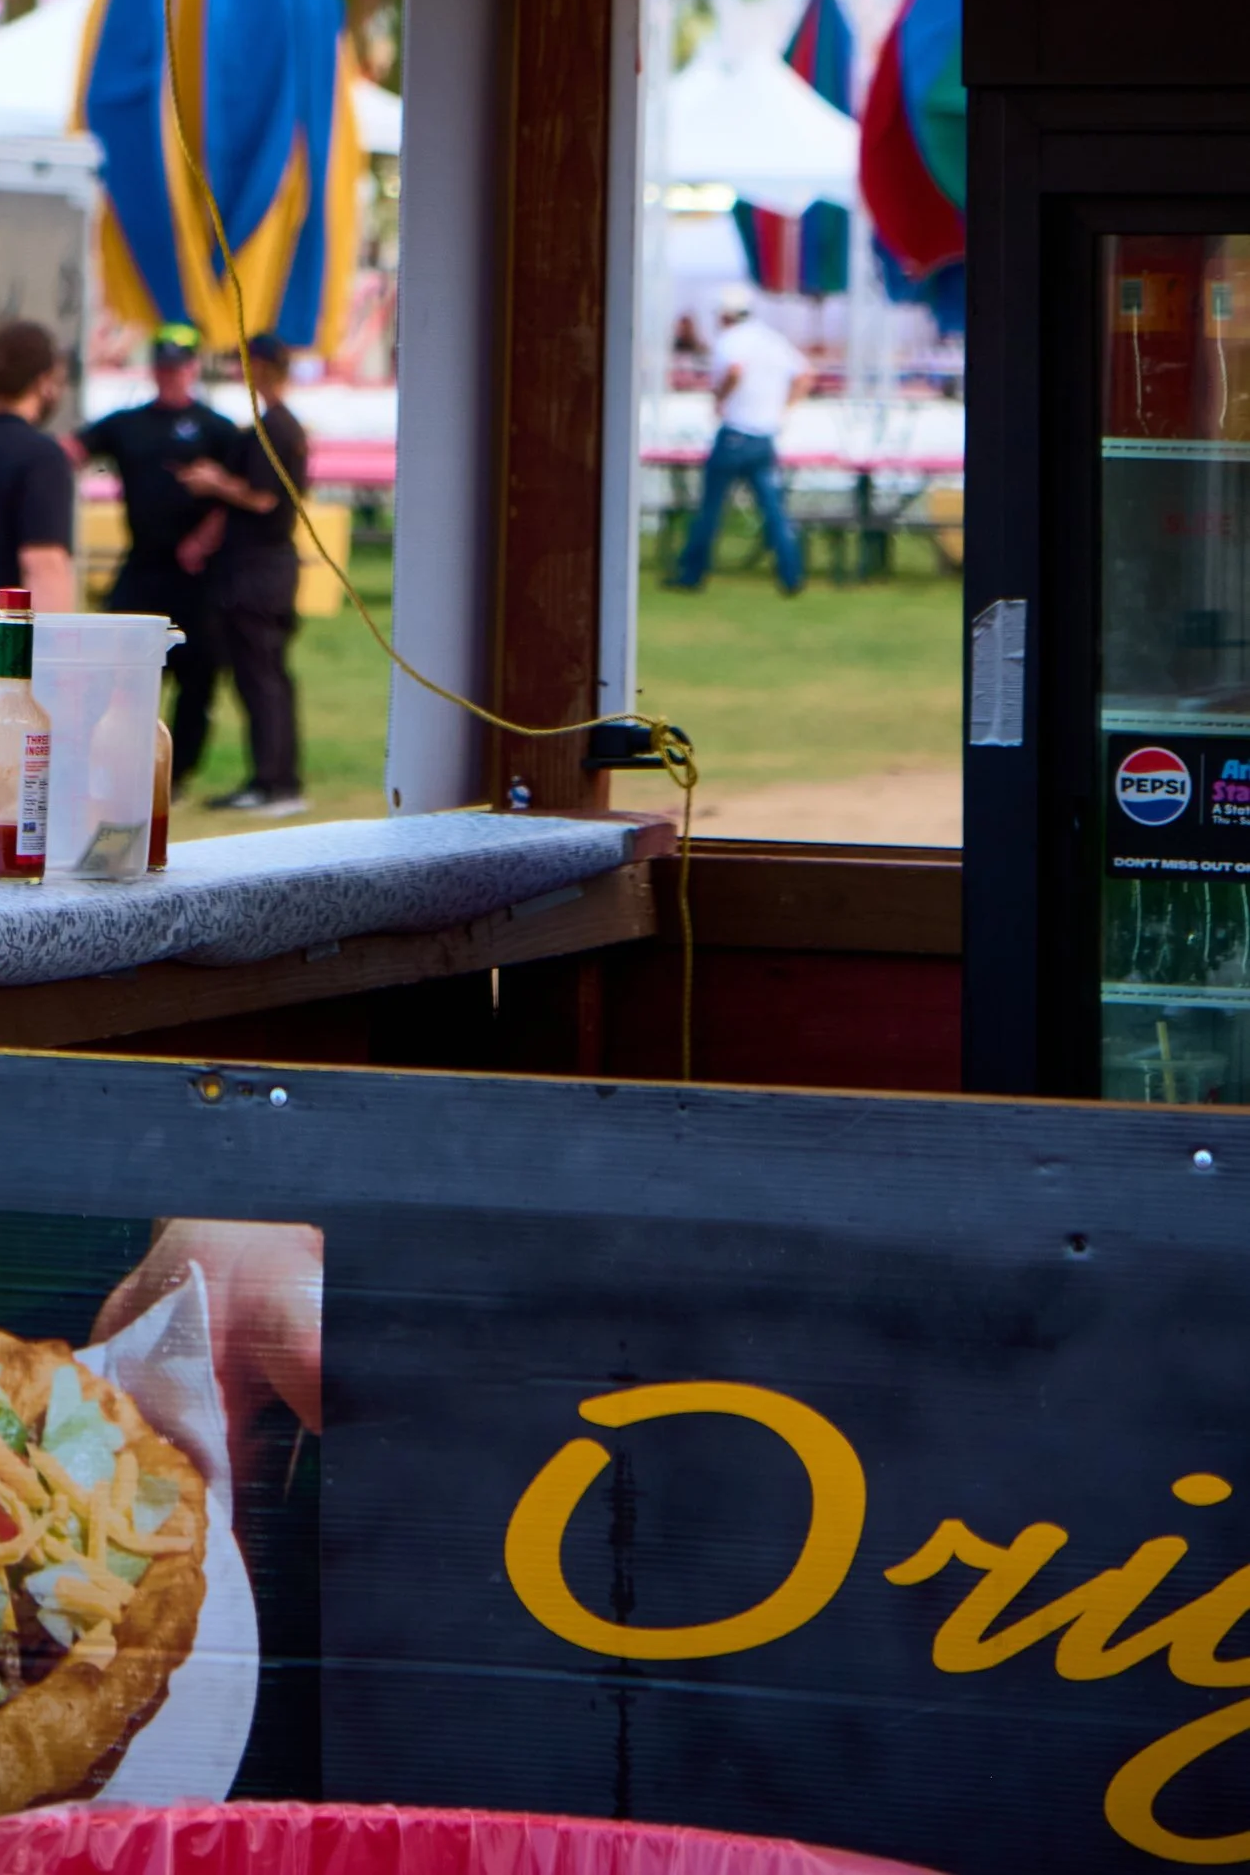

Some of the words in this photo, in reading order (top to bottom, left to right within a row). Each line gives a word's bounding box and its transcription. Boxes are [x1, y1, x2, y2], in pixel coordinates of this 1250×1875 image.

[1120, 777, 1187, 795] PEPSI
[1212, 803, 1222, 815] A
[1113, 857, 1159, 869] DON'T
[1161, 859, 1199, 871] MISS
[1200, 861, 1233, 872] OUT
